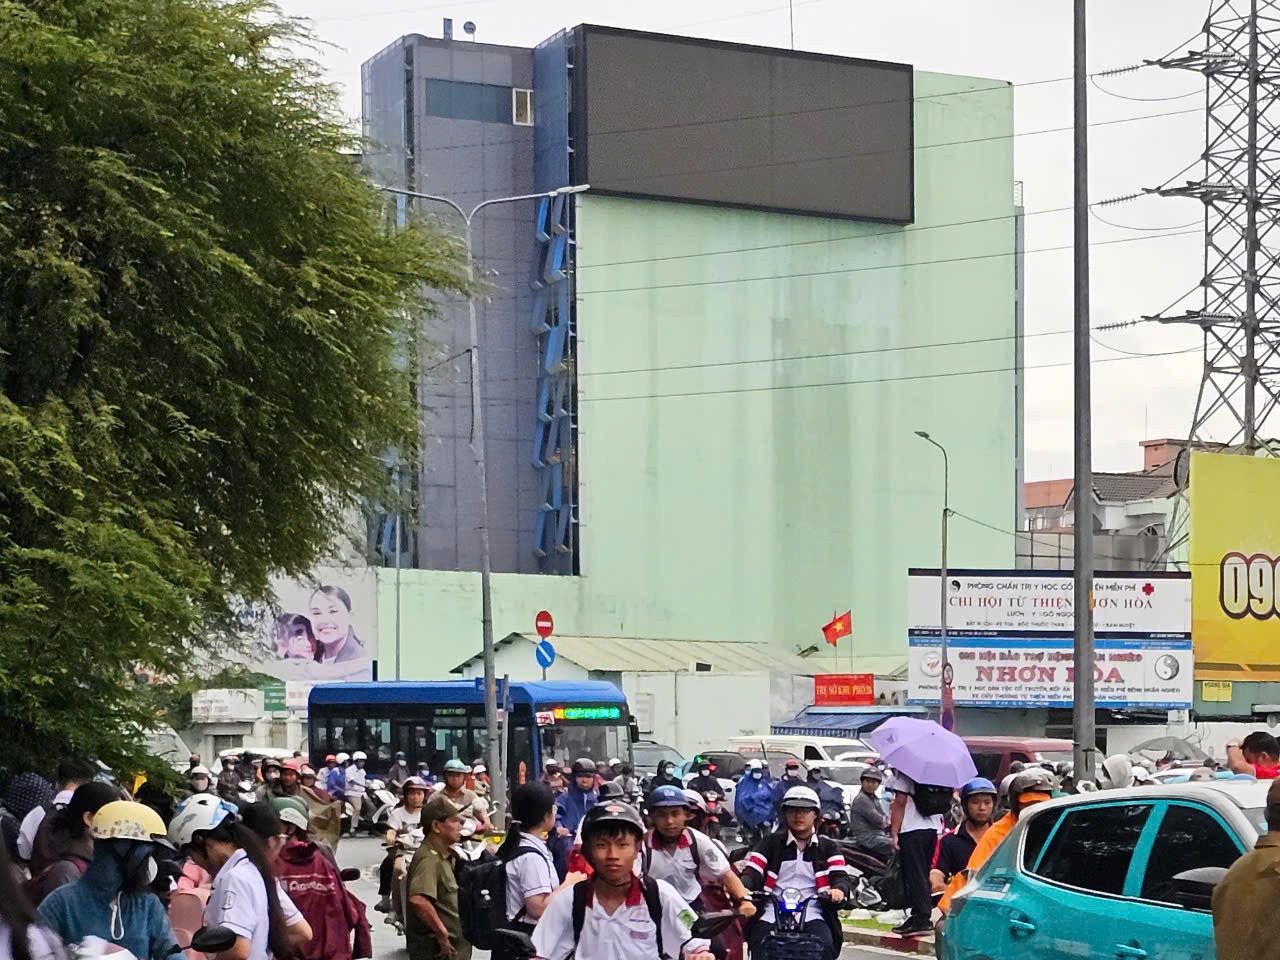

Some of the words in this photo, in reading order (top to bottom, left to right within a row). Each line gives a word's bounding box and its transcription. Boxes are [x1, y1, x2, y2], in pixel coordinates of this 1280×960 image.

[949, 597, 973, 608] CHI
[978, 596, 1002, 609] HỘI
[1031, 597, 1073, 611] THIỆN
[1124, 597, 1153, 609] HÒA
[975, 664, 1057, 683] NHƠN
